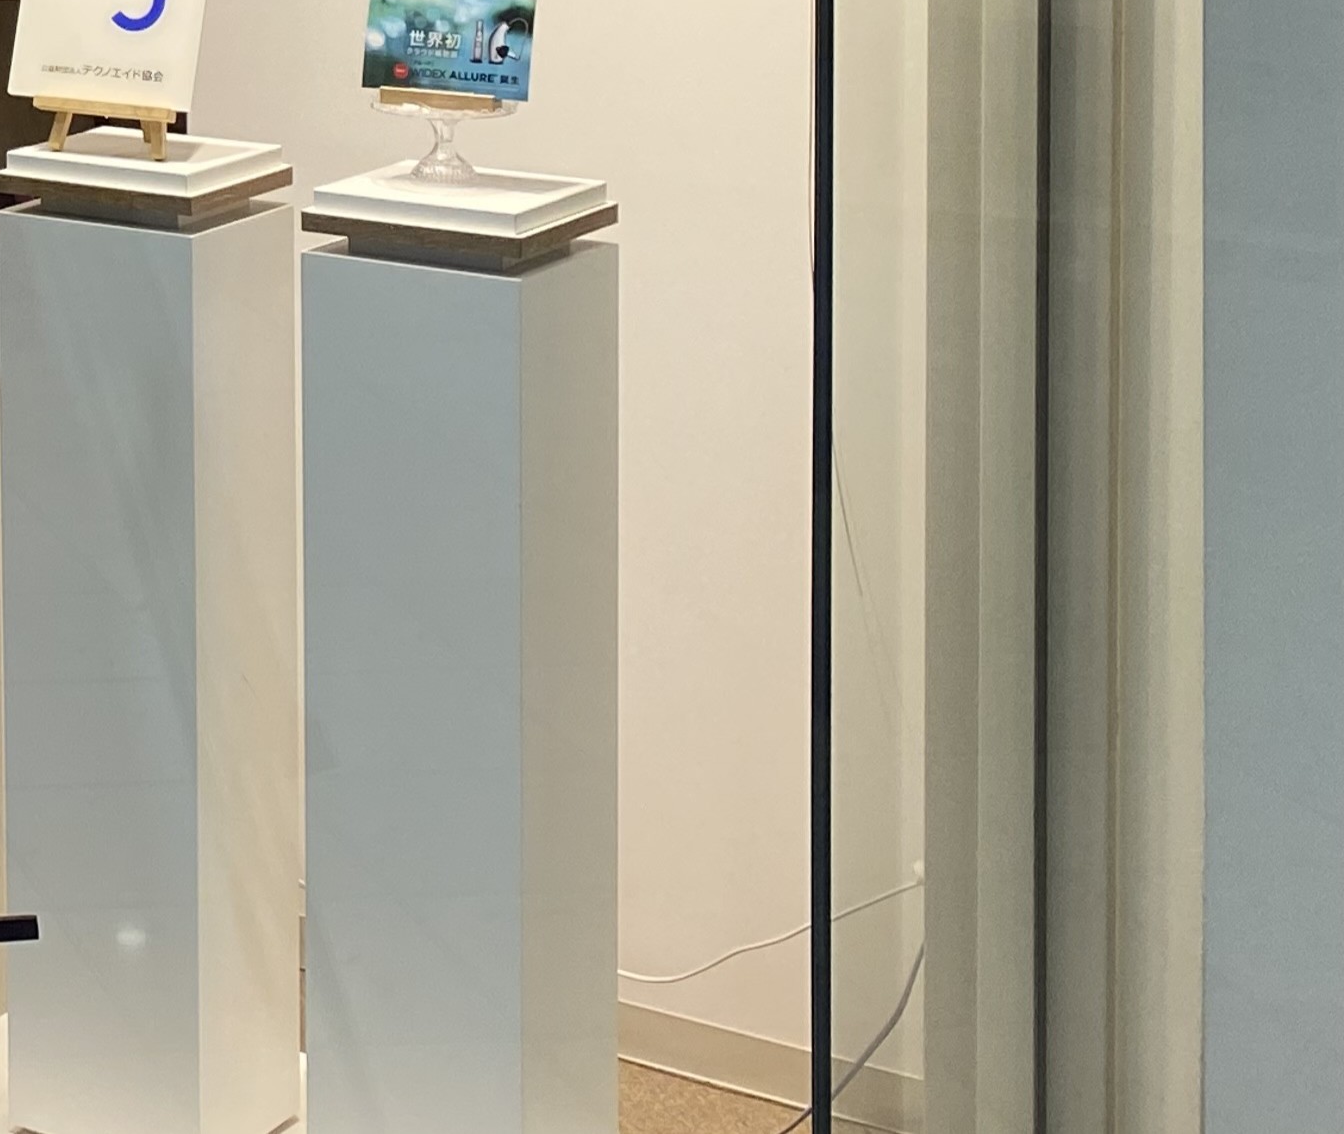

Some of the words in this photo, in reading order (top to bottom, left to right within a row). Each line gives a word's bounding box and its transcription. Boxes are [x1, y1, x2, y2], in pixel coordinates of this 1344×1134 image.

[408, 29, 461, 50] 世界初
[412, 67, 446, 80] WIDEX
